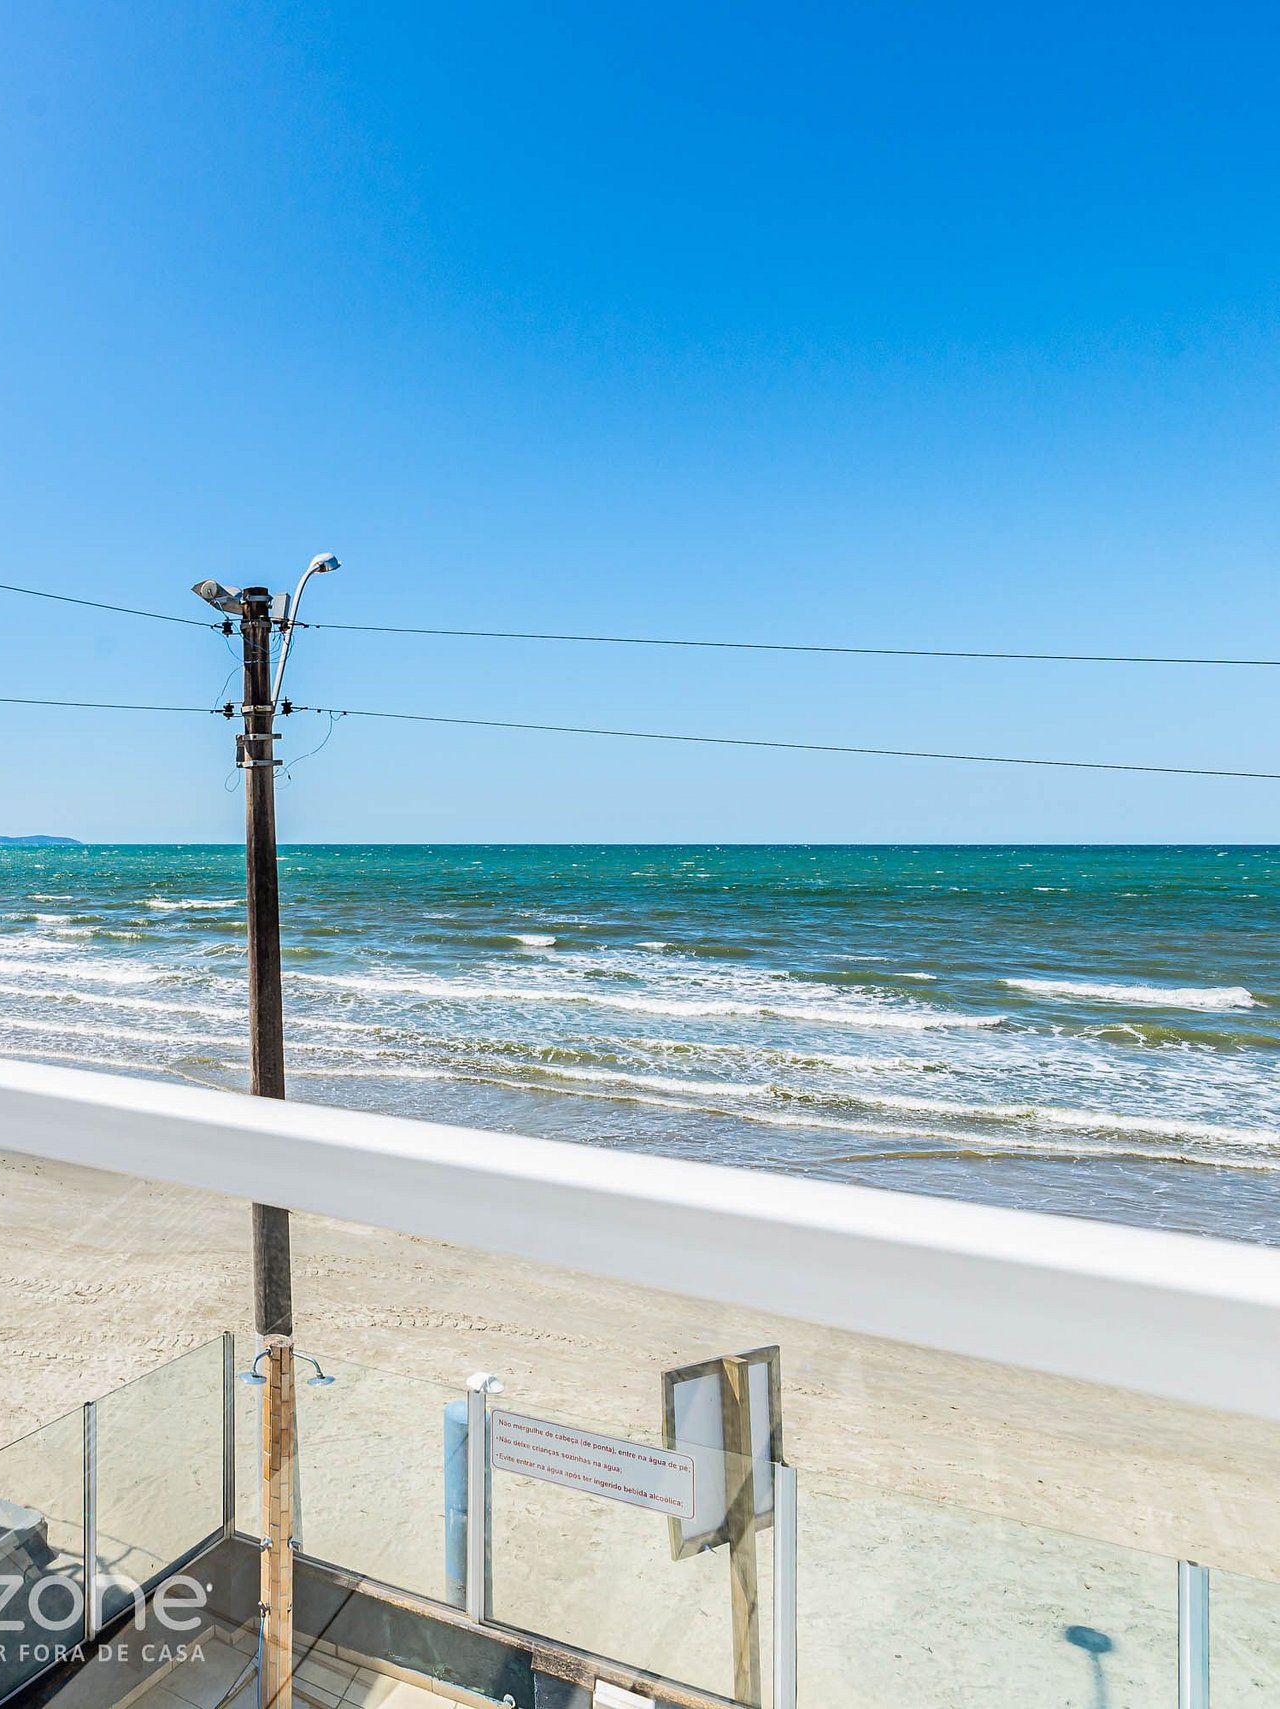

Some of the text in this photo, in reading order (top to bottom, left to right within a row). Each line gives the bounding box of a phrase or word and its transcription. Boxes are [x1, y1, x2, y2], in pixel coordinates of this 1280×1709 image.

[498, 1418, 512, 1428] Não
[512, 1422, 544, 1436] mergulhe
[544, 1430, 554, 1438] de
[554, 1432, 579, 1444] cabeça
[618, 1449, 636, 1460] entre
[637, 1454, 647, 1462] na
[648, 1456, 667, 1467] água
[667, 1461, 678, 1469] de
[531, 1445, 560, 1458] crianças
[561, 1452, 592, 1465] sozinhas
[592, 1460, 602, 1468] na
[515, 1457, 536, 1469] entrar
[536, 1463, 546, 1471] na
[546, 1464, 564, 1476] água
[564, 1470, 581, 1481] após
[582, 1474, 593, 1483] ter
[593, 1478, 622, 1492] ingerido
[623, 1484, 648, 1498] bebida
